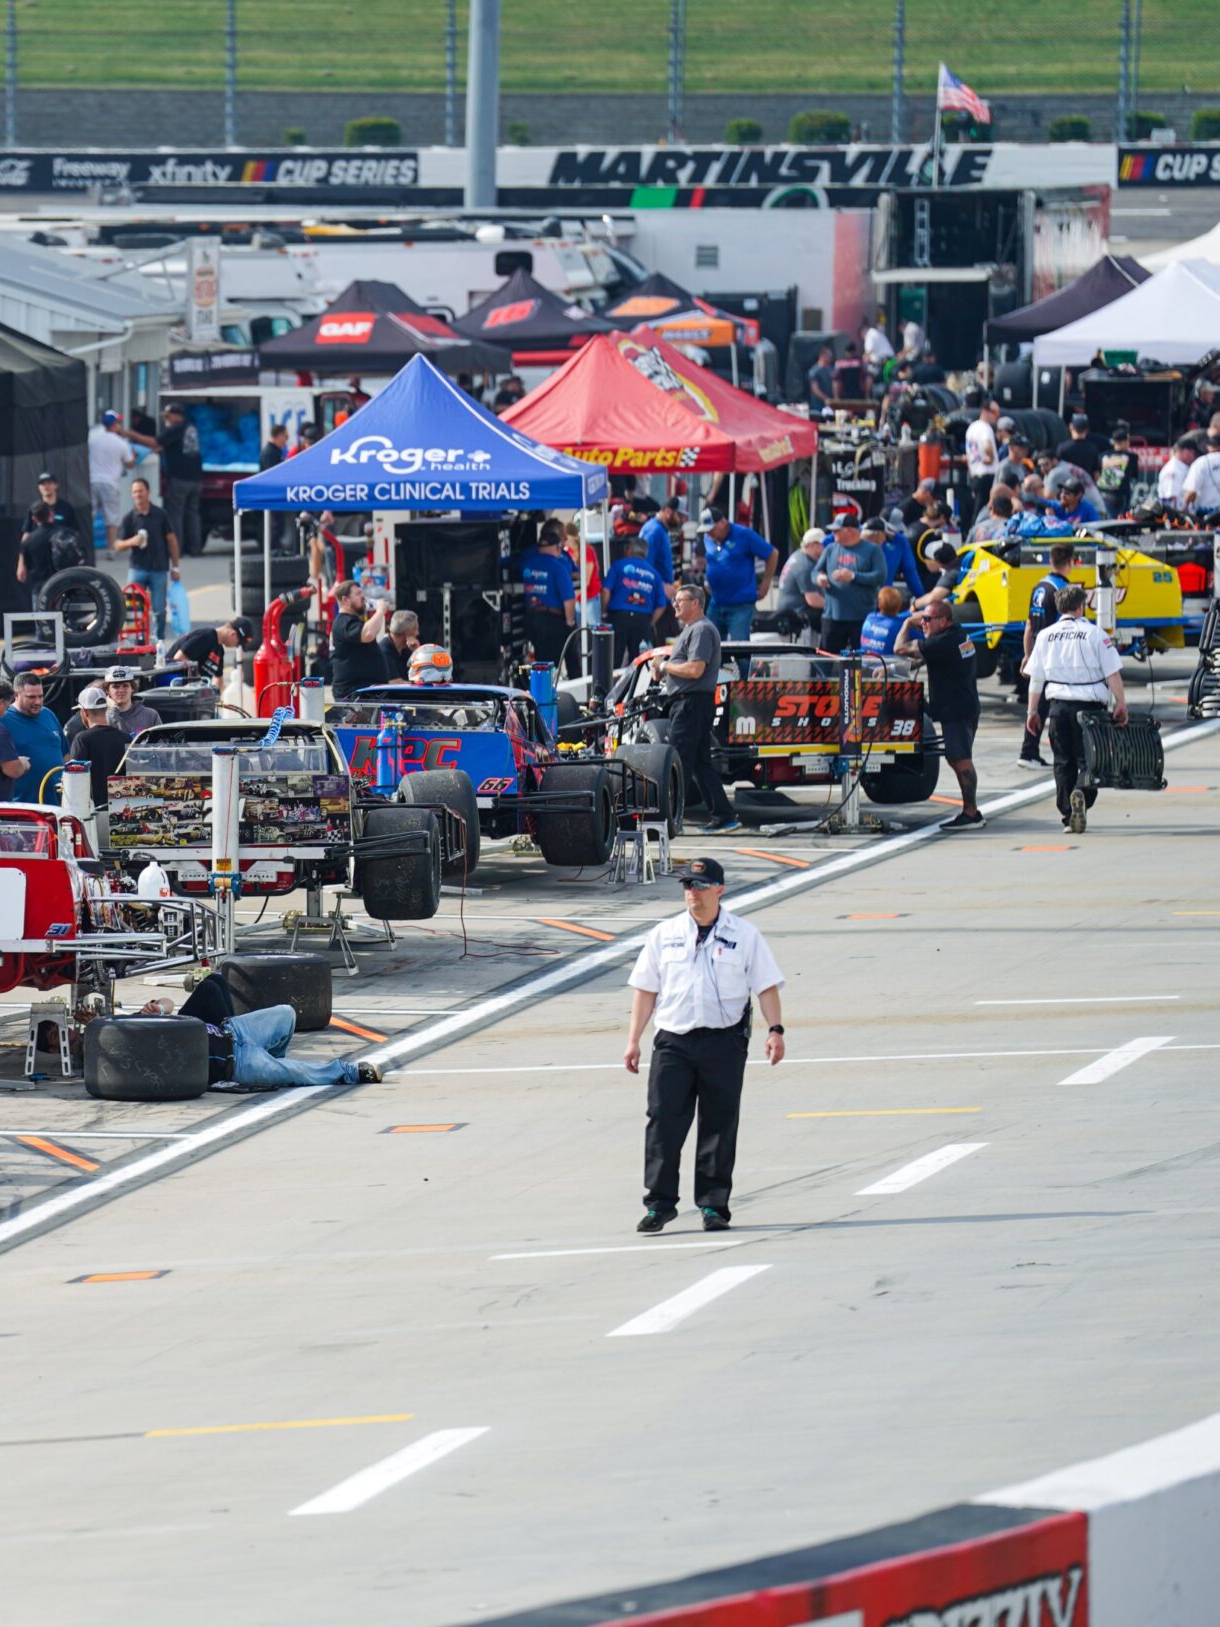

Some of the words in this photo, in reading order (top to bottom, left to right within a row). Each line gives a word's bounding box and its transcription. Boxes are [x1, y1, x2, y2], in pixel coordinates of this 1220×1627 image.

[52, 157, 131, 184] Freeway
[275, 160, 330, 185] CUP
[328, 160, 418, 185] SERIES
[1155, 154, 1208, 180] CUP
[331, 435, 464, 474] Kroger
[430, 461, 491, 472] health
[286, 484, 368, 502] KROGER
[374, 482, 465, 501] CLINICAL
[470, 481, 530, 500] TRIALS
[1048, 631, 1088, 643] OFFICIAL
[775, 695, 883, 718] STOE
[890, 719, 916, 736] 38
[45, 923, 73, 936] 31
